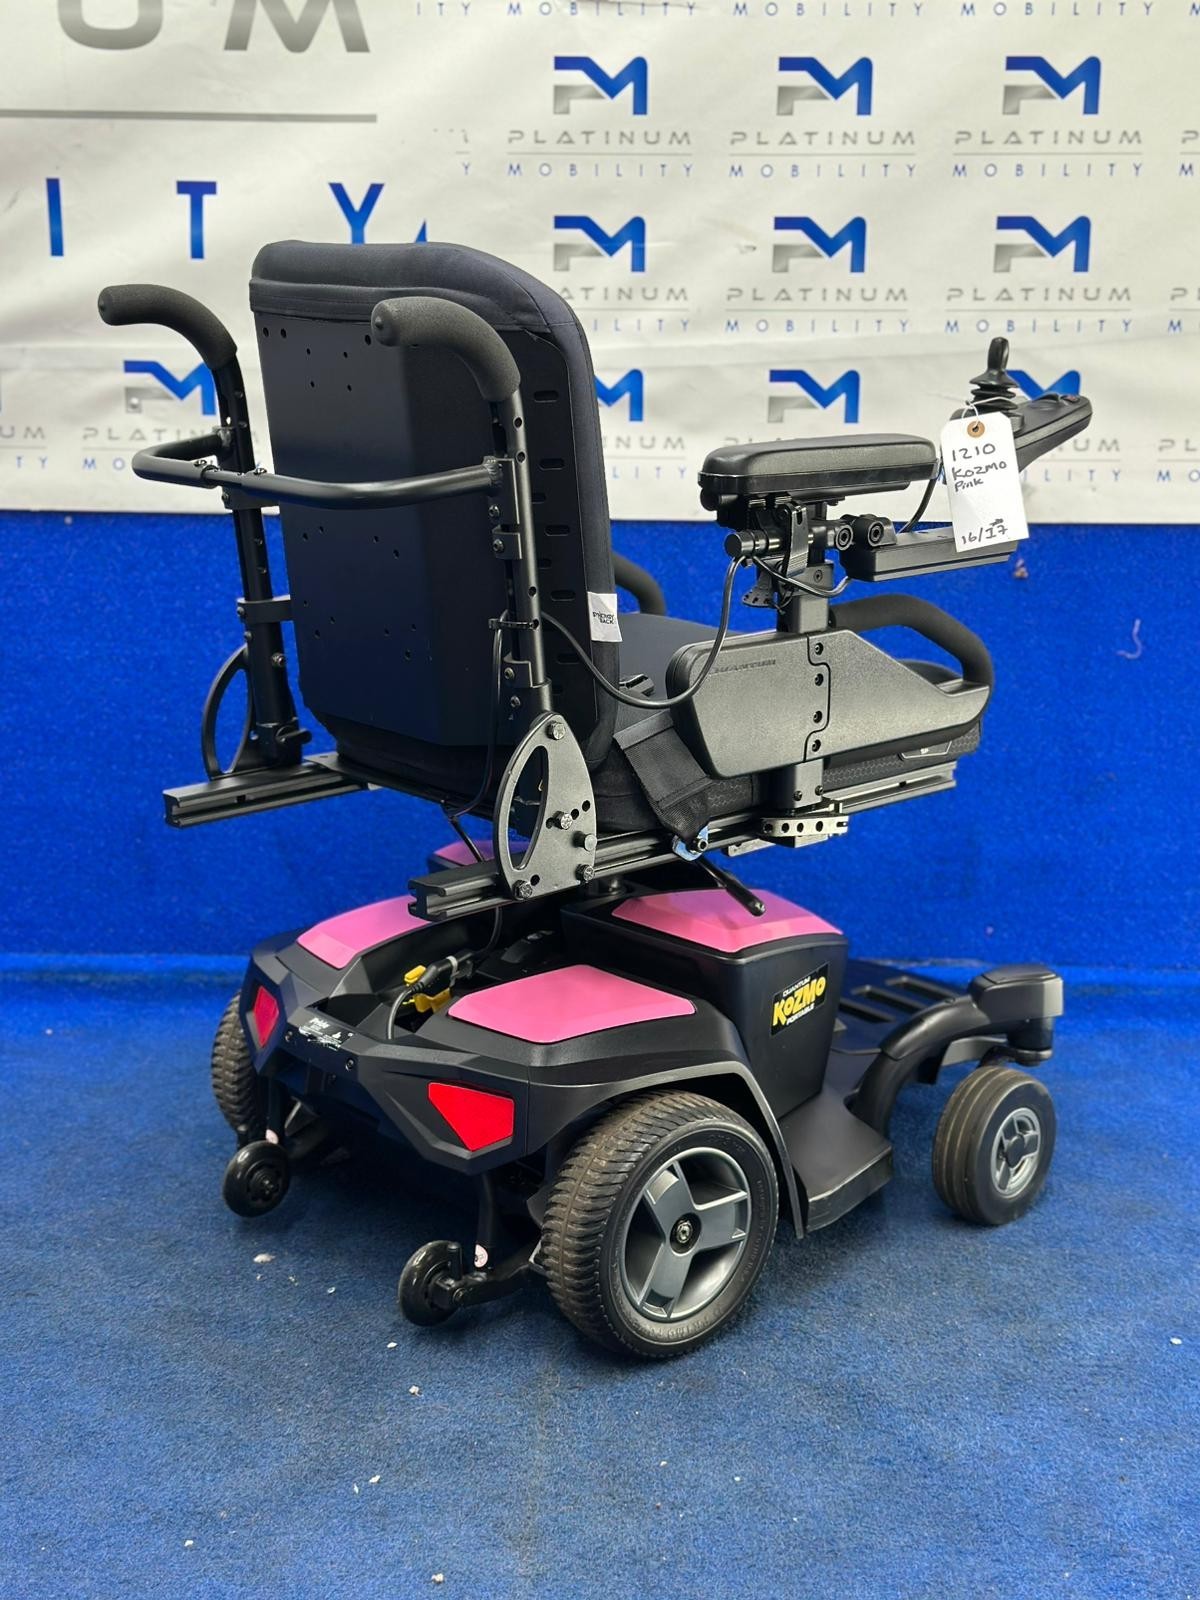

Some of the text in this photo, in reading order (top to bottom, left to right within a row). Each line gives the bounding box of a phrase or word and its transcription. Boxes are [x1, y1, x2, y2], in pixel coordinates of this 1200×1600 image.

[506, 2, 696, 16] MOBILITY
[733, 2, 923, 16] MOBILITY
[960, 2, 1152, 16] MOBILITY
[507, 129, 692, 145] PLATINUM
[729, 130, 916, 146] PLATINUM
[954, 129, 1143, 145] PLATINUM
[507, 162, 694, 178] MOBILITY
[729, 163, 917, 178] MOBILITY
[952, 162, 1143, 177] MOBILITY
[561, 287, 689, 301] ATINUM
[726, 287, 909, 302] PLATINUM
[946, 286, 1133, 302] PLATINUM
[593, 319, 690, 332] ILITY
[724, 318, 909, 333] MOBILITY
[944, 318, 1133, 333] MOBILITY
[952, 443, 996, 462] 1210
[1023, 469, 1120, 482] ILITY
[954, 478, 984, 492] Pink
[772, 976, 826, 1027] KOZMO
